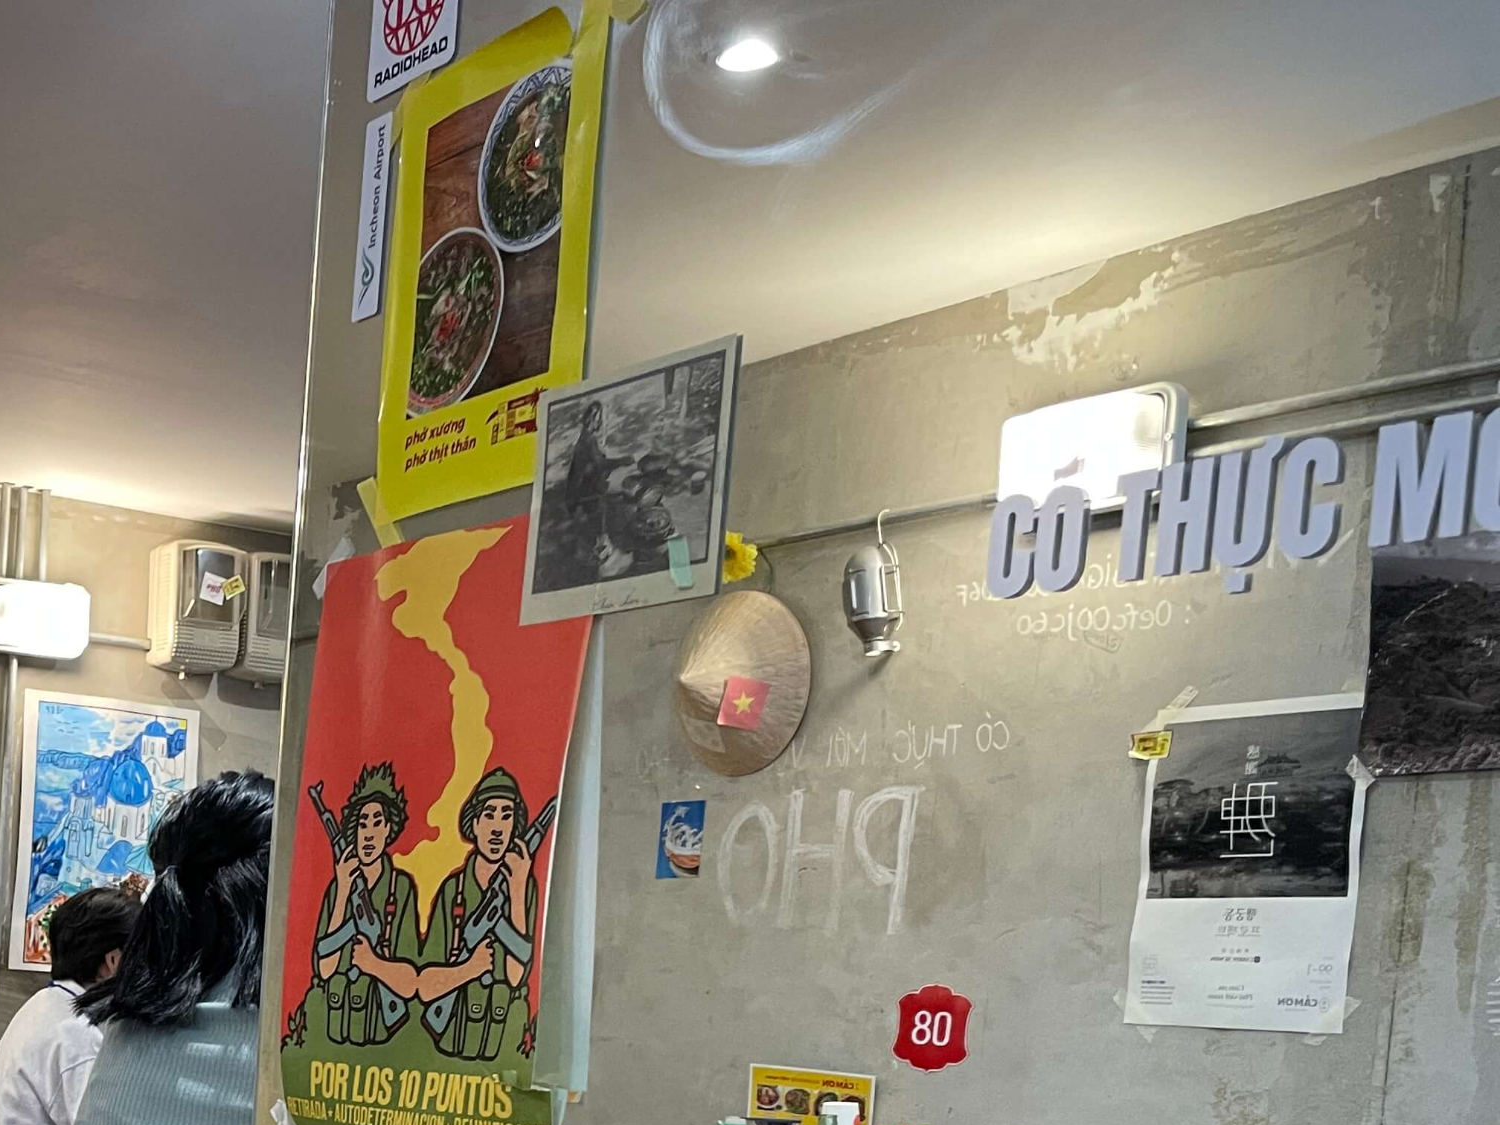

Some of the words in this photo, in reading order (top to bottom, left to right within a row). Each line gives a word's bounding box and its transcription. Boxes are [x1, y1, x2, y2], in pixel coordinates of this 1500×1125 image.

[374, 35, 449, 89] RADIOHEAD
[373, 124, 387, 182] Airport
[367, 183, 382, 250] Incheon
[286, 1096, 328, 1122] RETIRADA
[310, 1060, 349, 1100] POR
[352, 1064, 393, 1106] LOS
[399, 1071, 421, 1108] 10
[421, 1072, 513, 1119] PUNTOS
